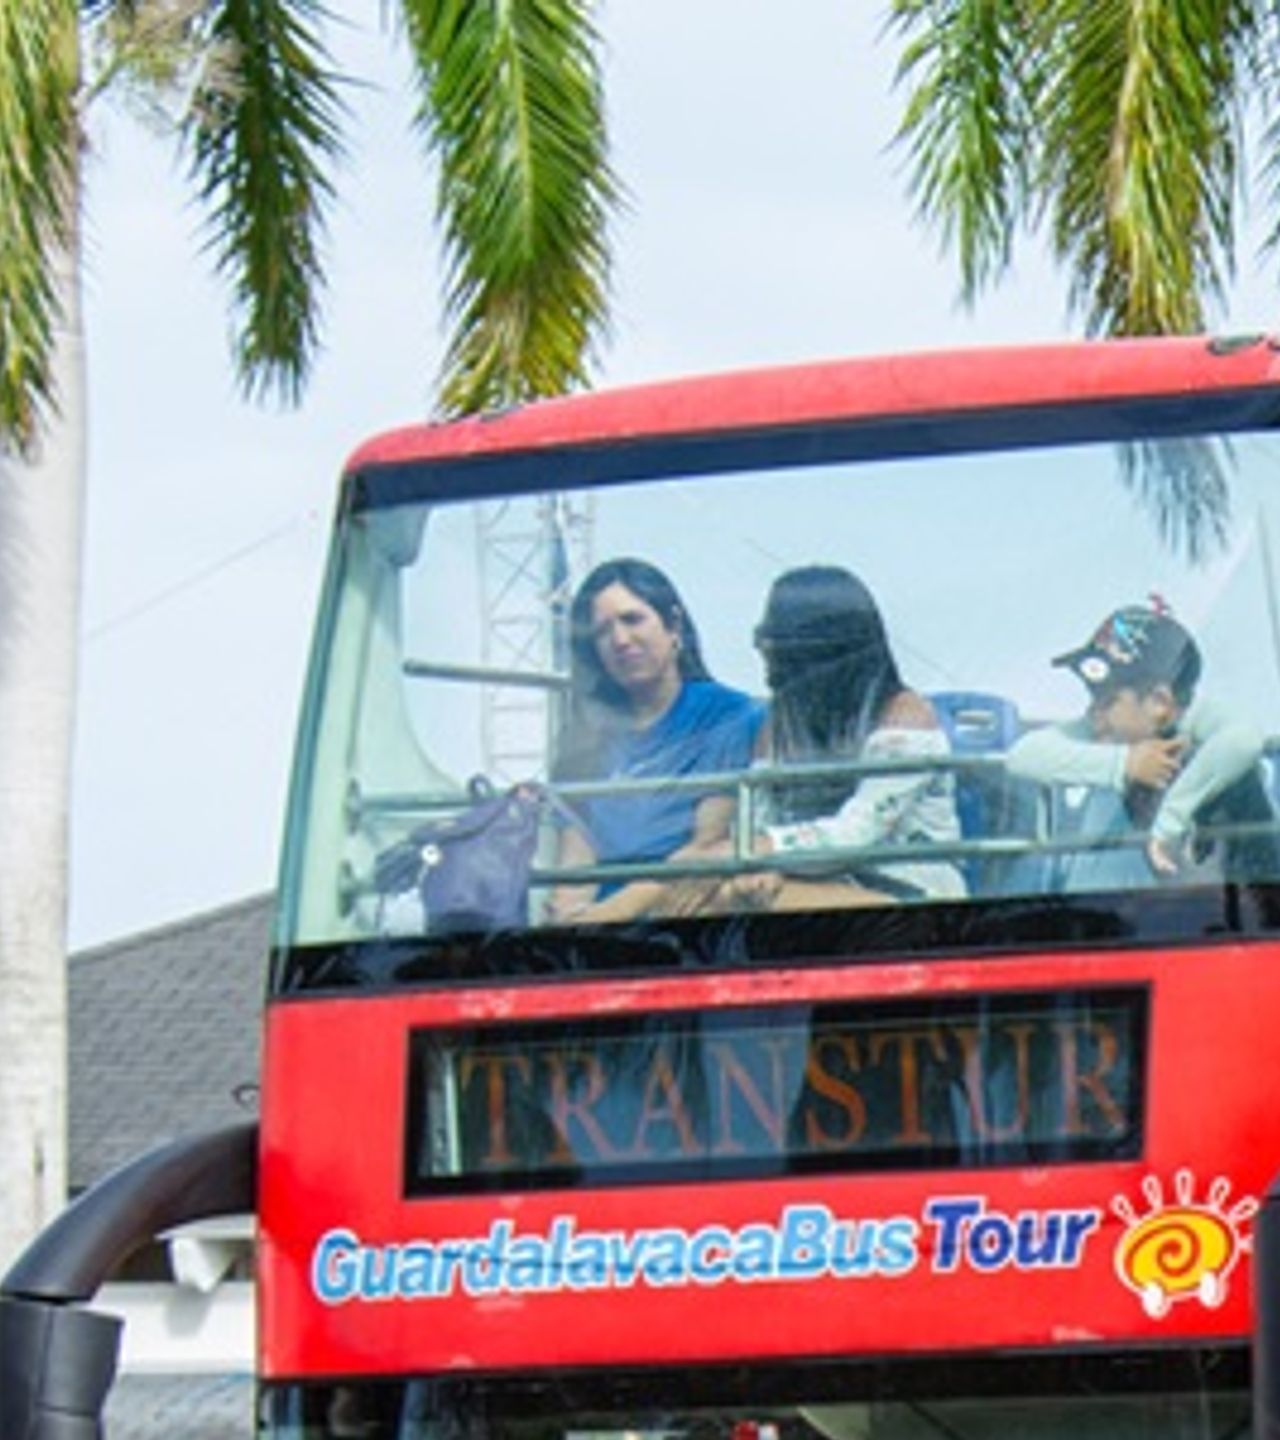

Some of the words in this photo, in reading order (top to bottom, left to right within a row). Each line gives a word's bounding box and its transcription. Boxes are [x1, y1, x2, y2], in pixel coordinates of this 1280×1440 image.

[460, 1022, 1130, 1168] TRANSTUR
[312, 1204, 916, 1303] GuardalavacaBus
[925, 1197, 1096, 1272] Tour
